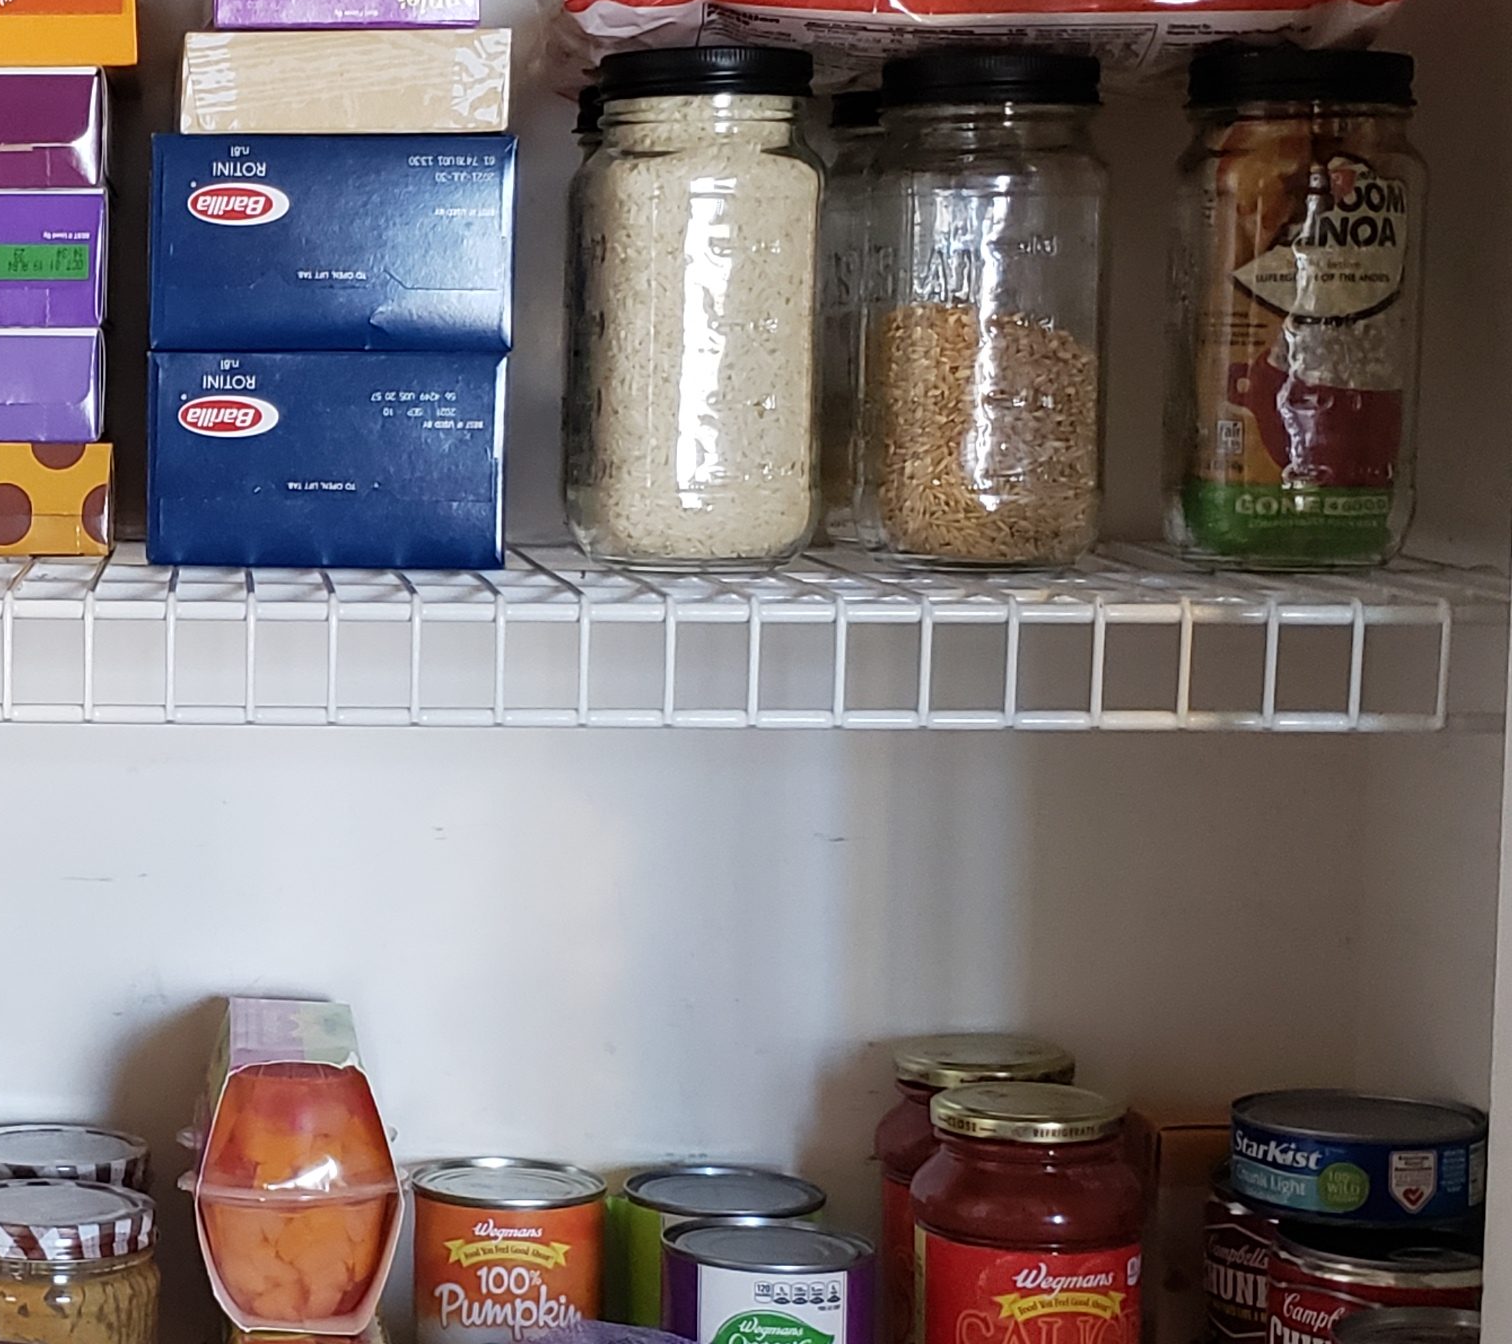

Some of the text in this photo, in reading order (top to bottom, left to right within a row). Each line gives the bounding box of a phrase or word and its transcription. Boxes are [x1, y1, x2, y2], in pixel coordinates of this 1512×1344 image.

[213, 161, 267, 177] ROTINI
[196, 188, 267, 216] Barilla
[203, 375, 256, 390] ROTINI
[187, 407, 256, 428] Barilla
[1235, 1130, 1324, 1170] StarKist
[473, 1218, 543, 1244] Wegmans
[476, 1266, 543, 1295] 100%
[1012, 1262, 1115, 1301] Wegmans
[434, 1282, 582, 1341] Pumpkin
[738, 1317, 804, 1340] Wegmans
